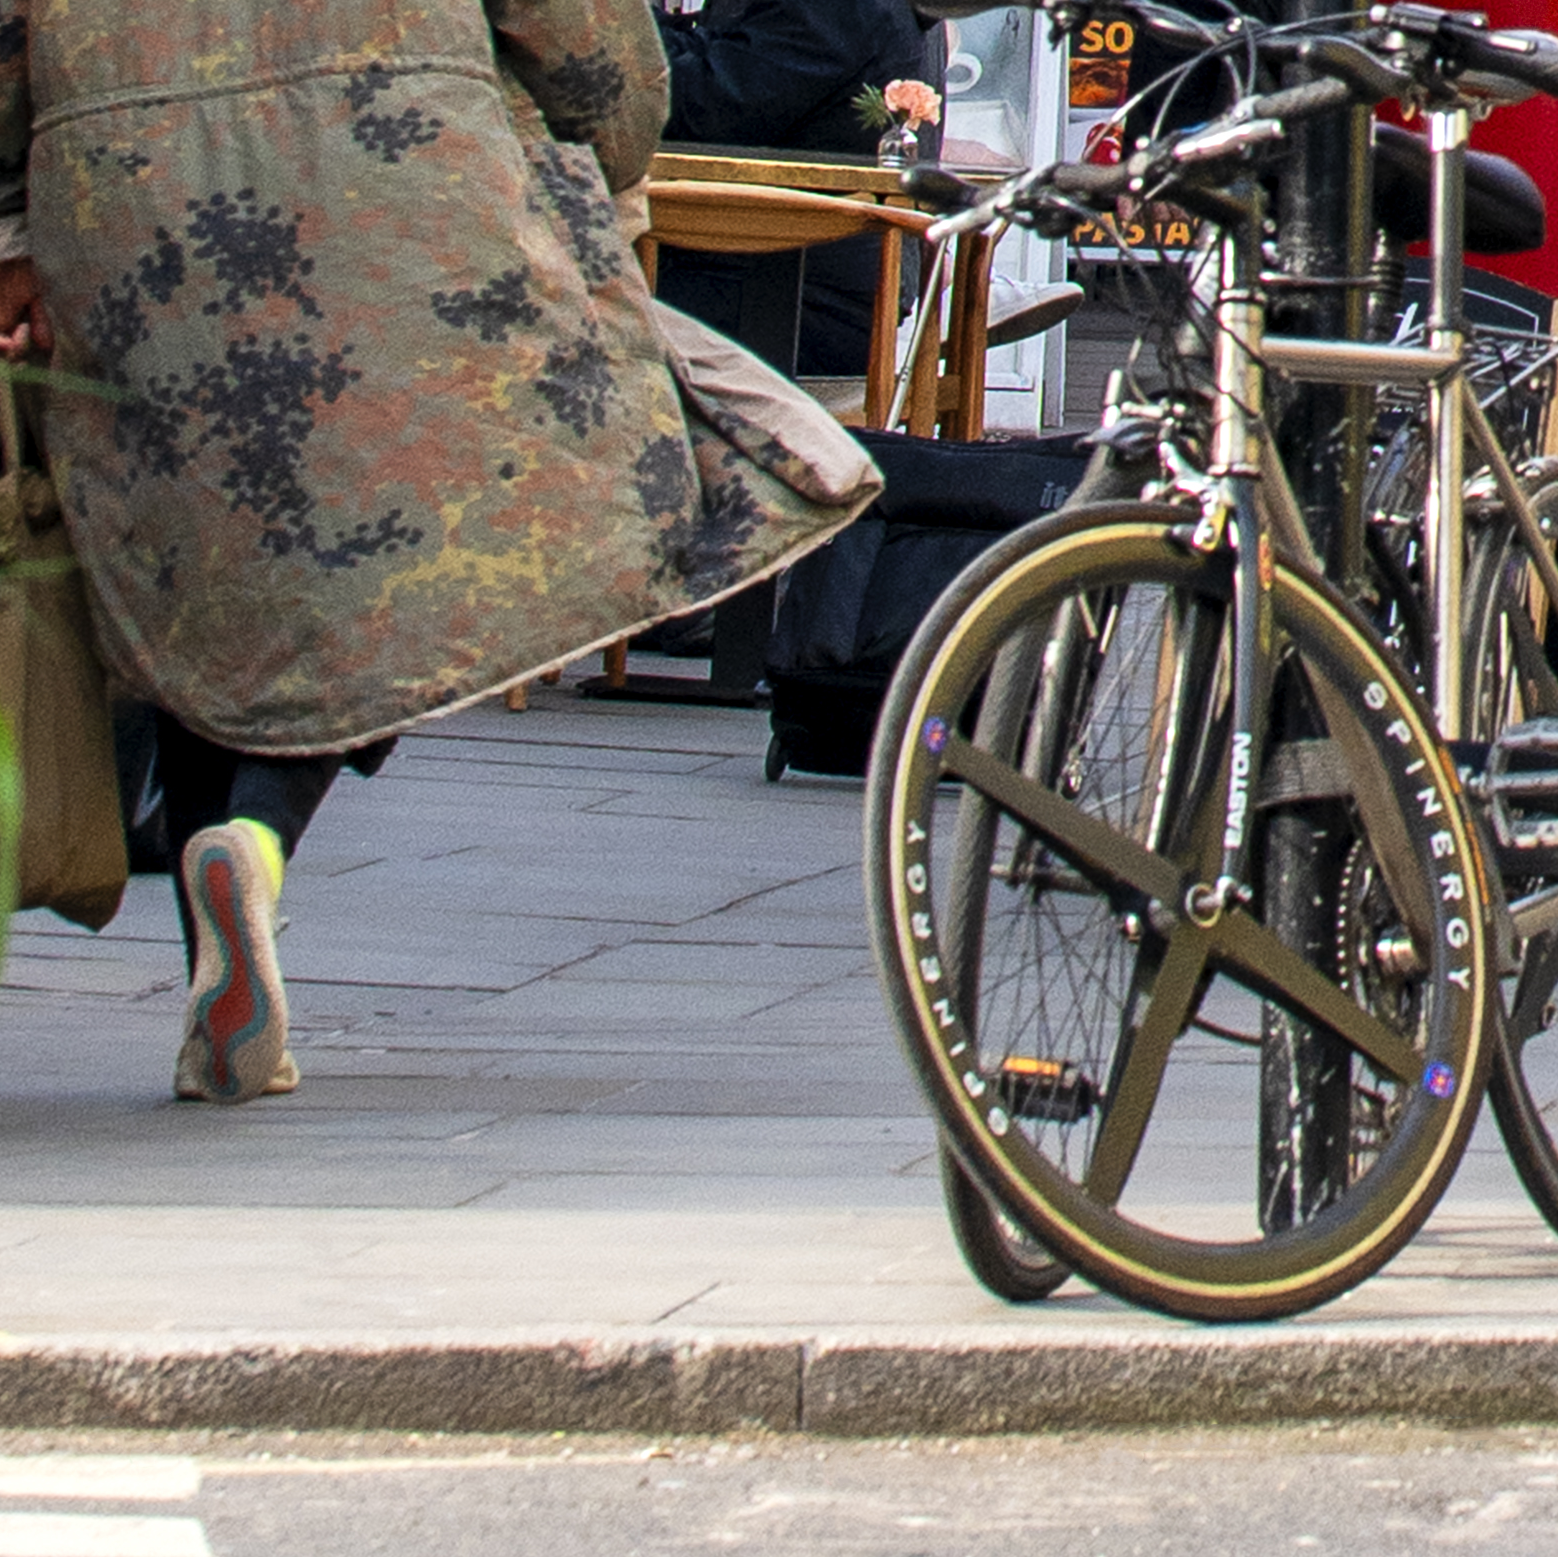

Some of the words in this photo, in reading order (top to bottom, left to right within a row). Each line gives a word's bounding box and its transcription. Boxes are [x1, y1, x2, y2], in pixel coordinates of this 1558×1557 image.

[1223, 731, 1252, 849] EASTON
[1362, 681, 1470, 991] SPINERGY
[906, 820, 1010, 1137] SPINERGY
